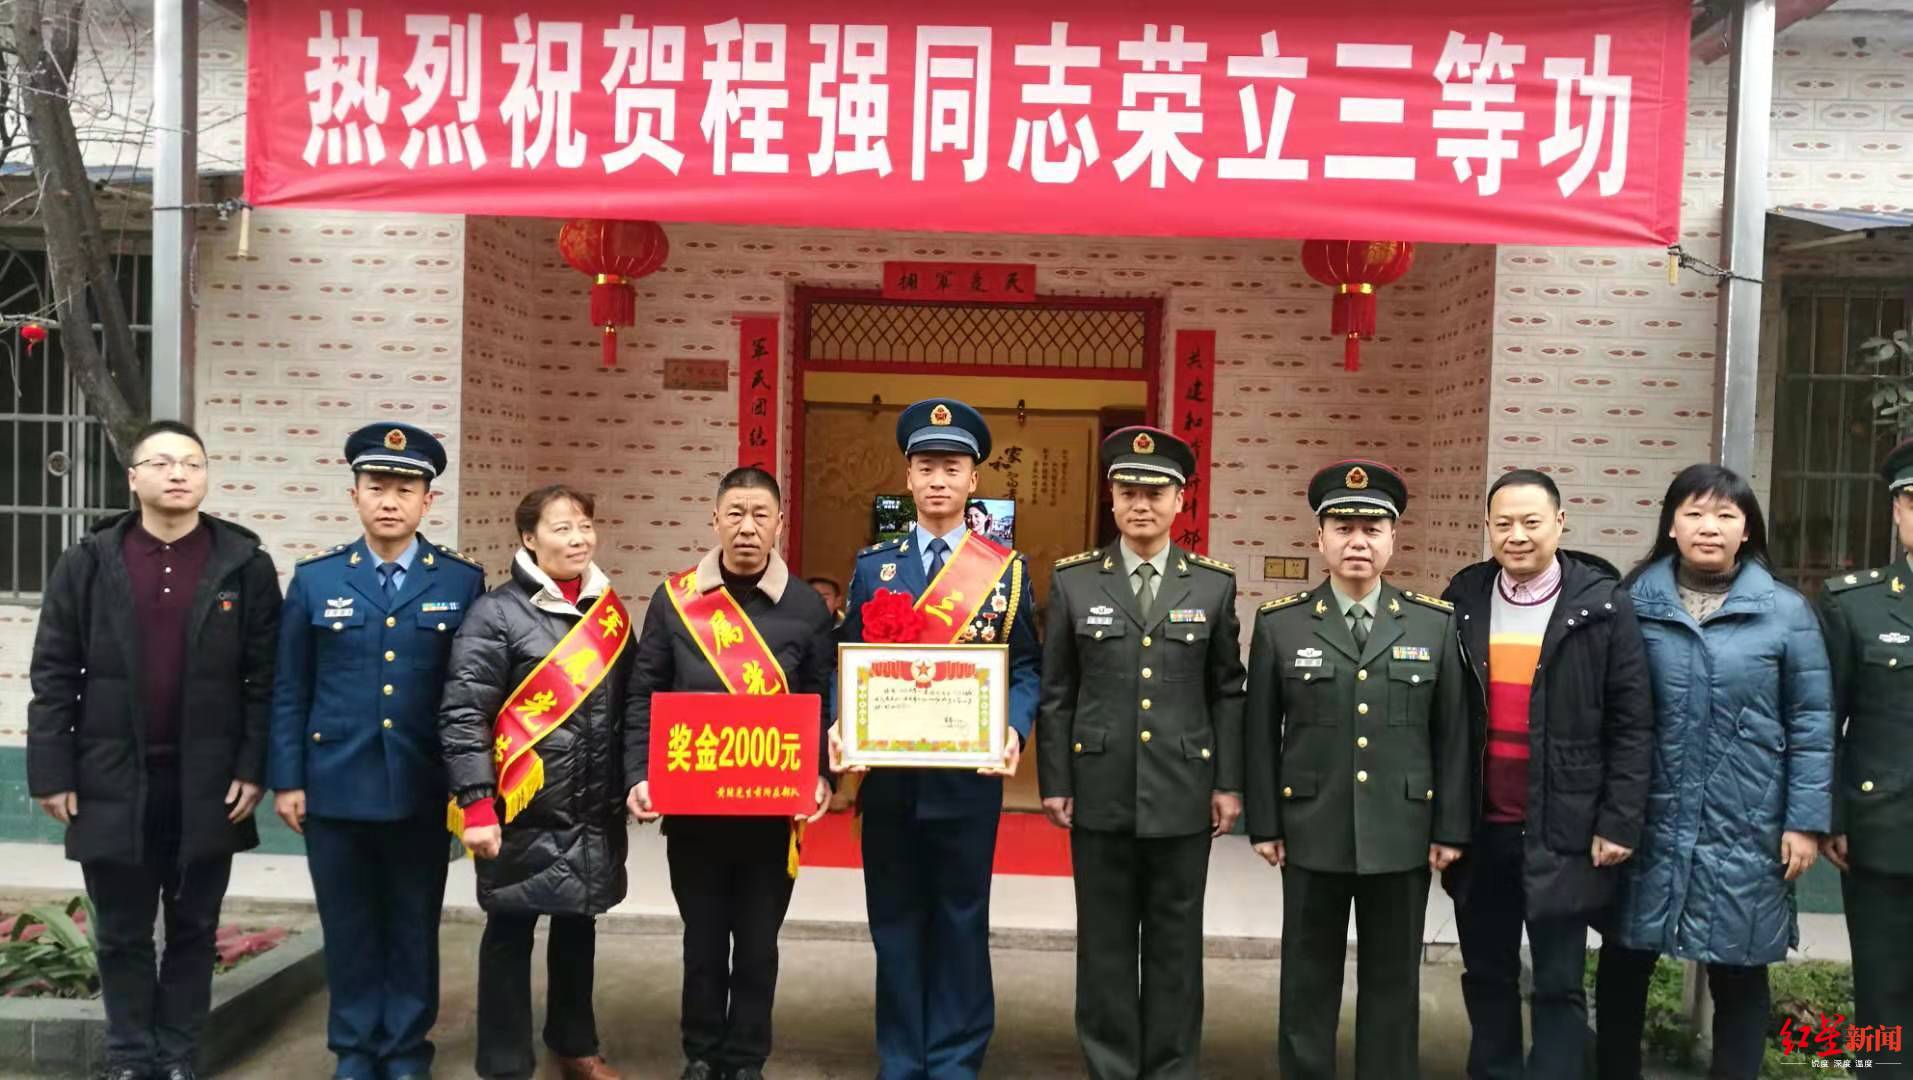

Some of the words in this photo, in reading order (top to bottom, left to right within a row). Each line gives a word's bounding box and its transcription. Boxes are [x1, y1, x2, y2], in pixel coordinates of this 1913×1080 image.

[302, 9, 1632, 198] 热烈祝贺程强同志荣立三等功
[666, 722, 802, 773] 奖金2000元
